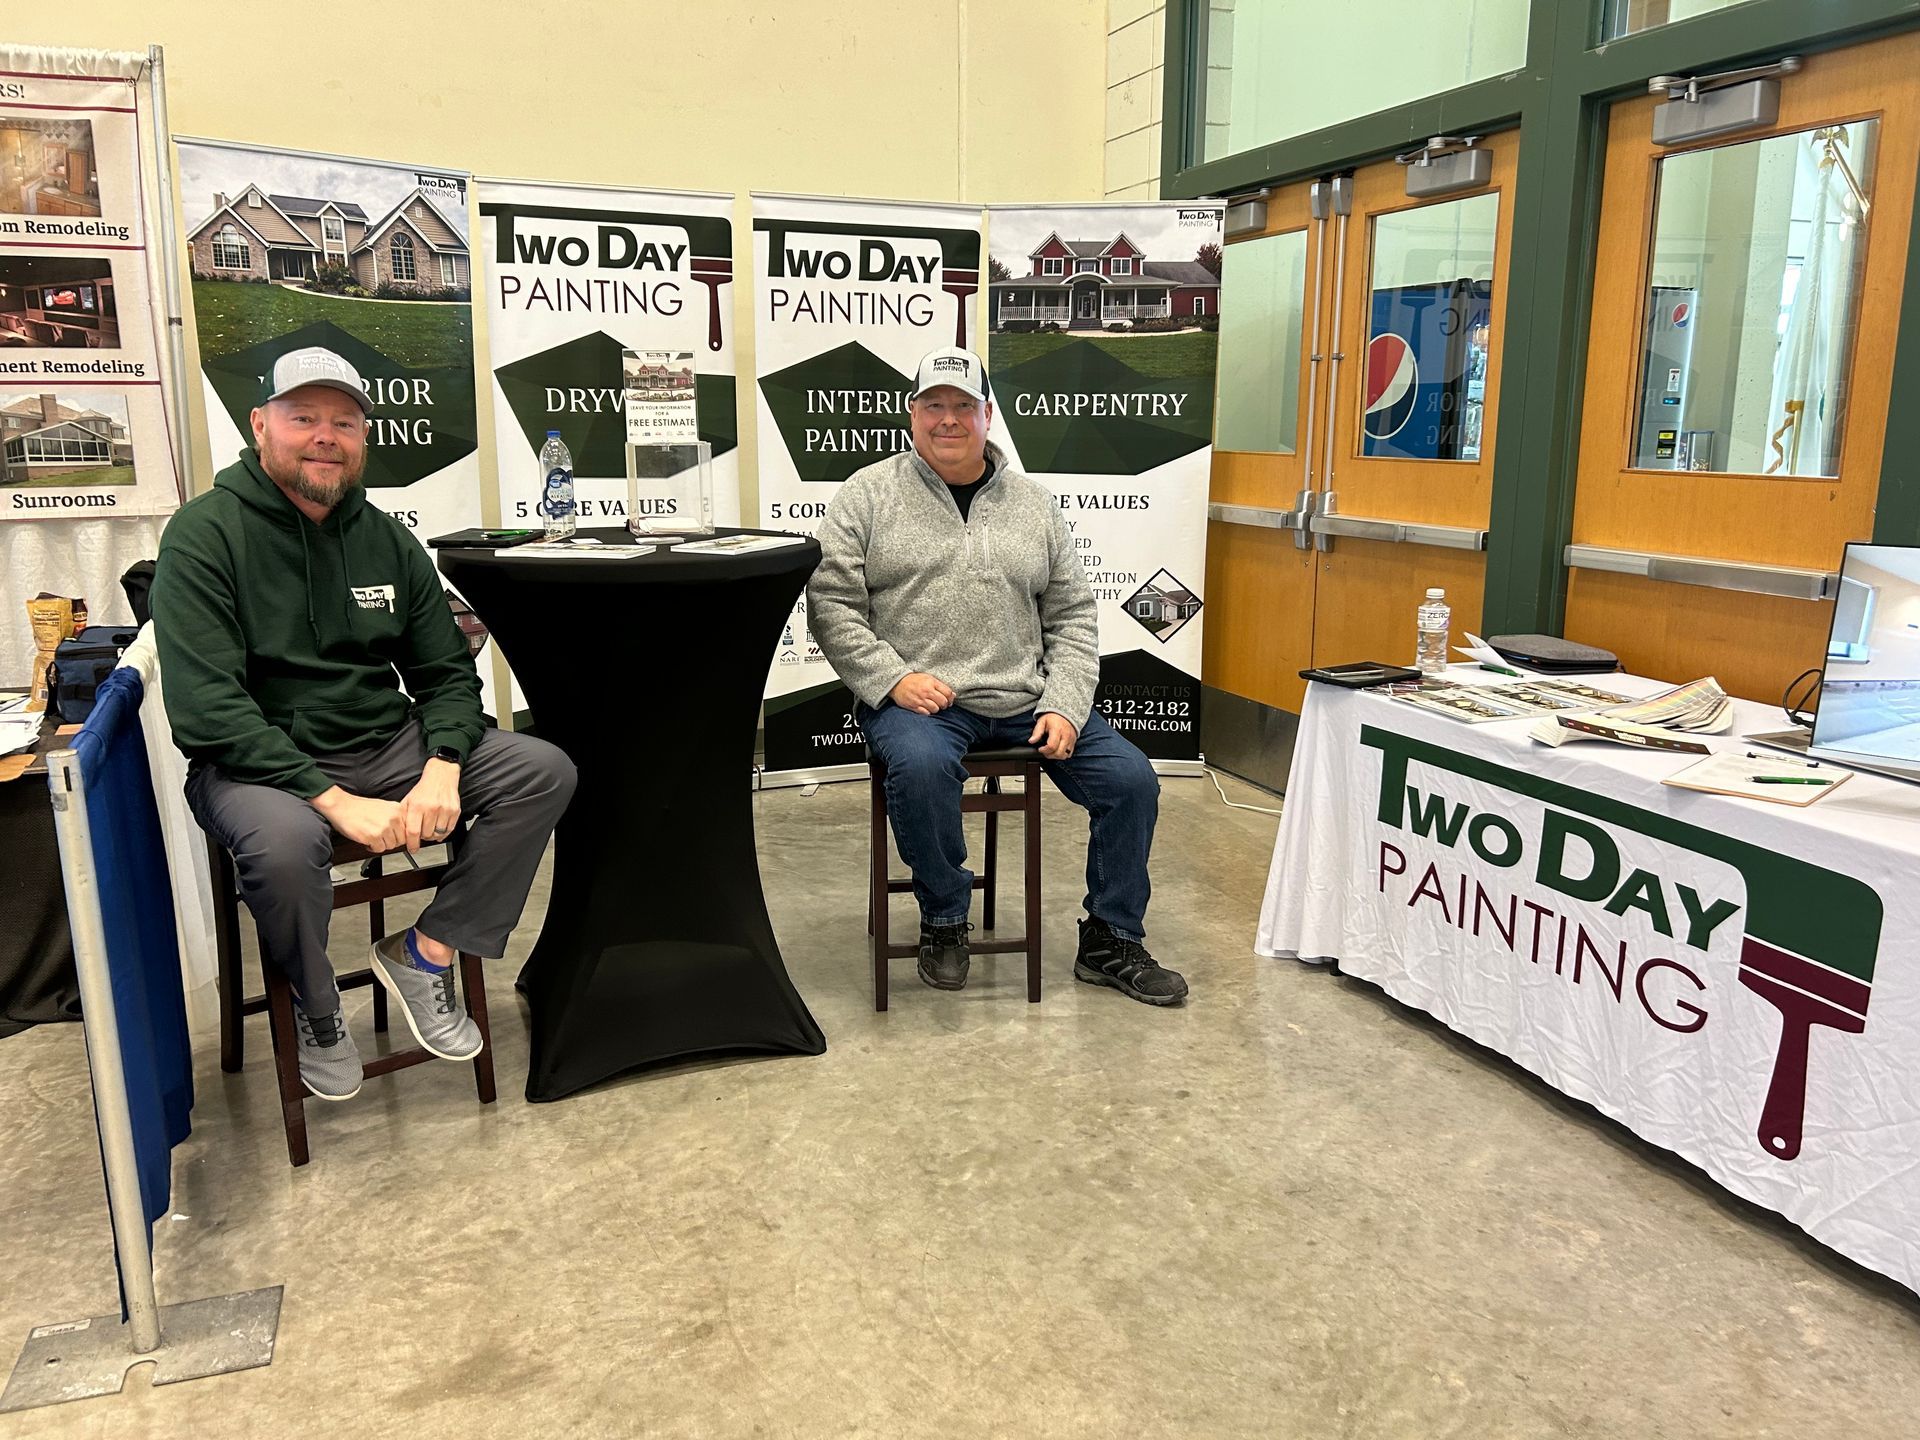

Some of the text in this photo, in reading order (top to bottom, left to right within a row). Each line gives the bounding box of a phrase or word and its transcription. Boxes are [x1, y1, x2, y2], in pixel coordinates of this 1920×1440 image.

[419, 187, 457, 199] PAINTING
[24, 220, 130, 240] Remodeling
[1179, 220, 1214, 228] PAINTING
[500, 275, 683, 316] PAINTING
[770, 288, 934, 327] PAINTING
[42, 360, 145, 376] Remodeling
[545, 387, 626, 413] DRYW
[807, 389, 912, 414] INTERI
[1015, 393, 1188, 417] CARPENTRY
[629, 418, 695, 427] FREE ESTIMATE
[805, 428, 913, 452] PAINTIN
[13, 494, 116, 508] Sunrooms
[1077, 494, 1150, 510] VALUES
[516, 502, 528, 518] 5
[771, 503, 828, 519] 5 COR
[1104, 684, 1191, 698] CONTACT US
[1095, 699, 1190, 716] -312-2182
[1107, 717, 1192, 732] INTING.COM
[1379, 840, 1709, 1034] PAINTING
